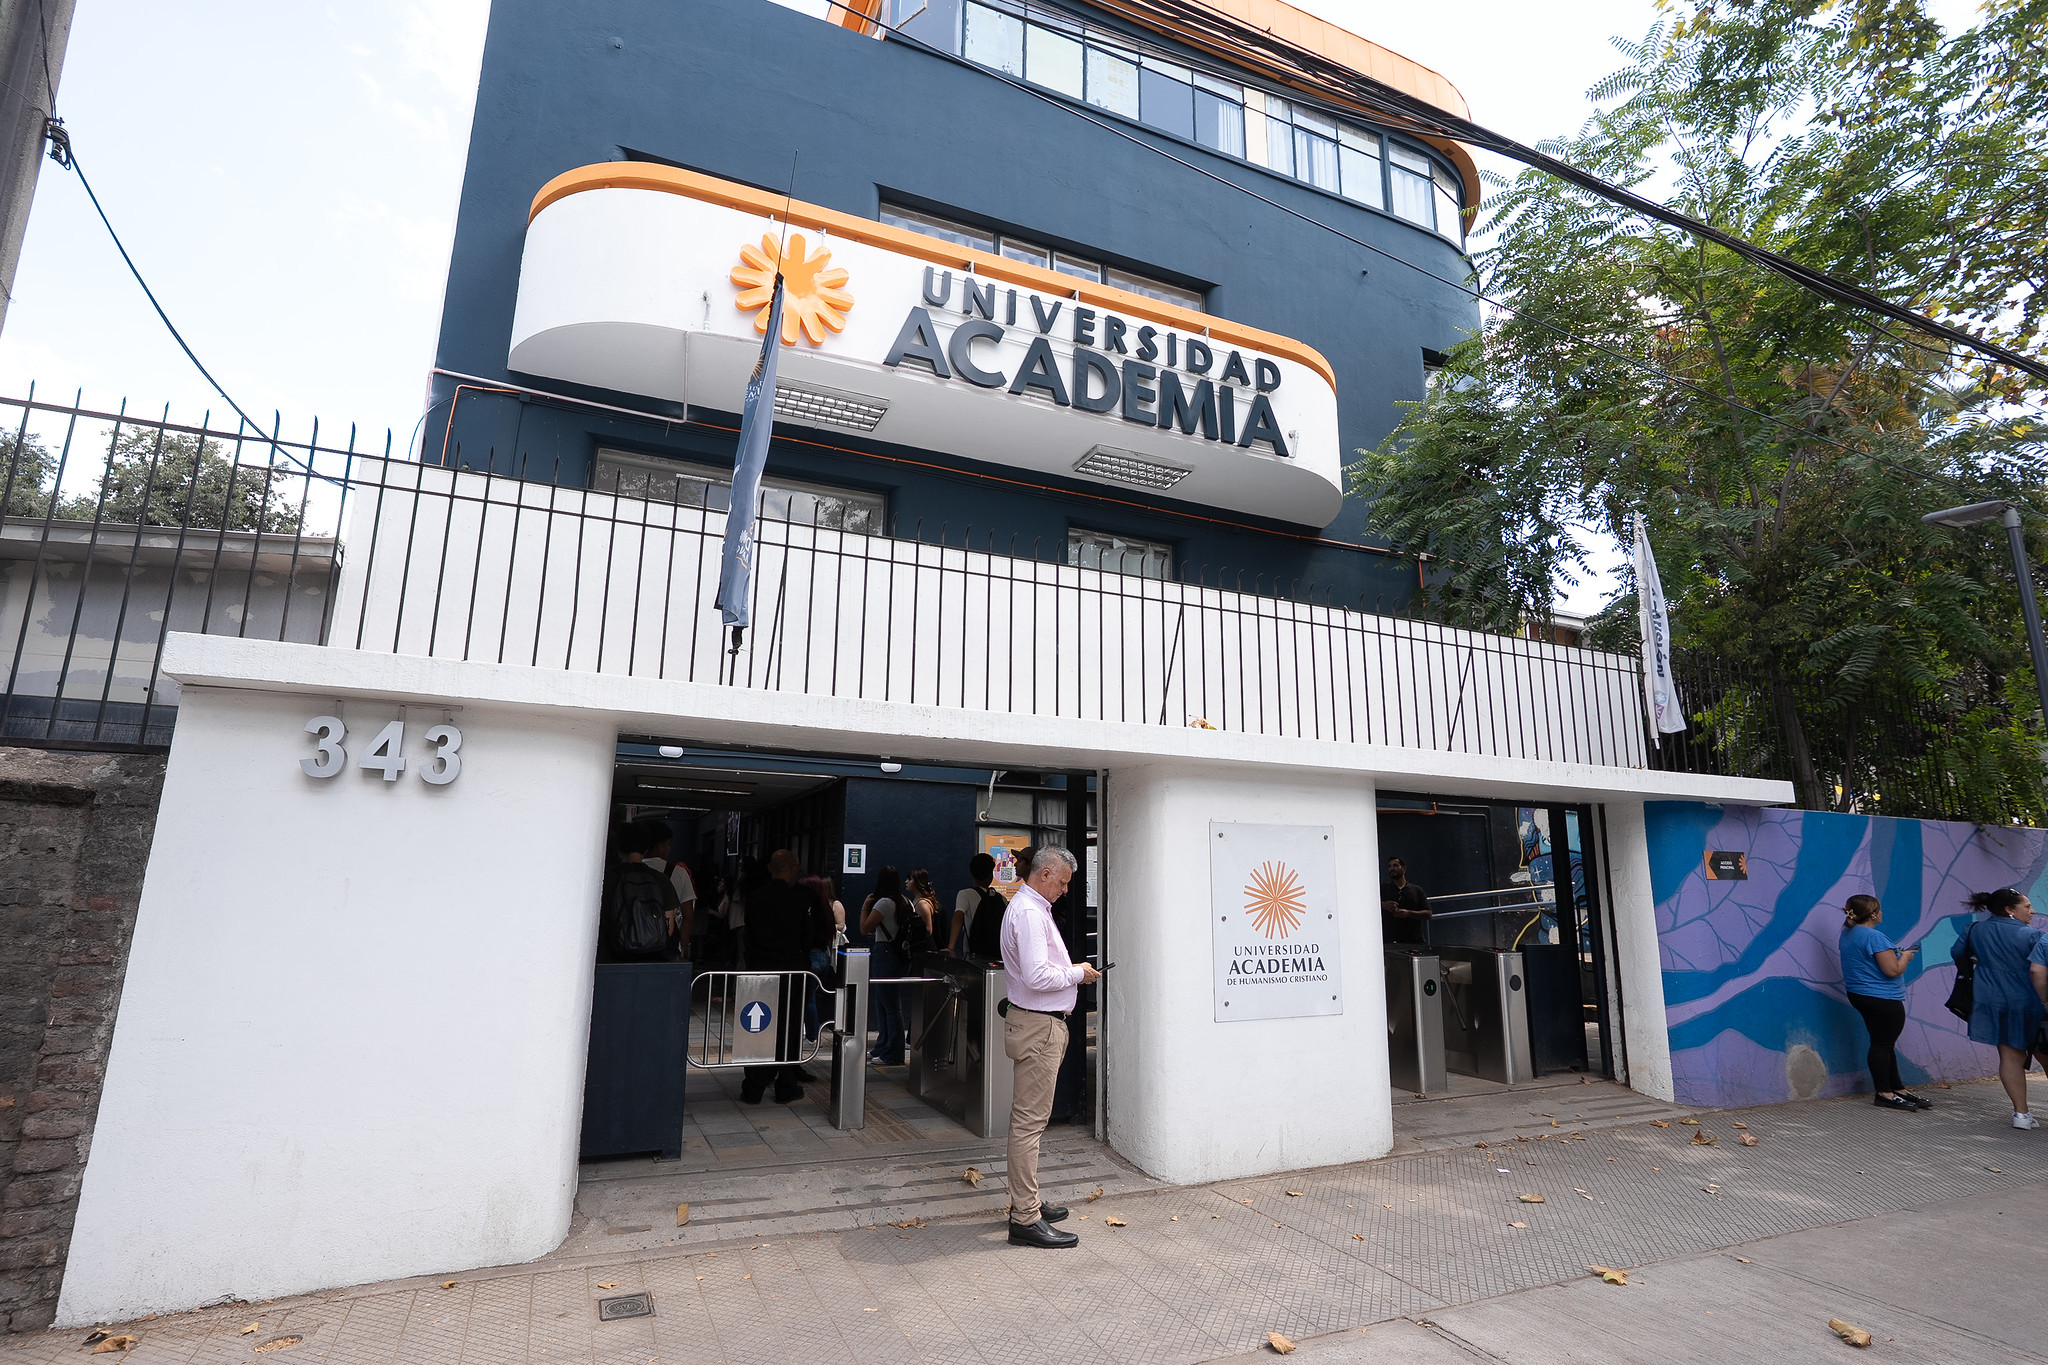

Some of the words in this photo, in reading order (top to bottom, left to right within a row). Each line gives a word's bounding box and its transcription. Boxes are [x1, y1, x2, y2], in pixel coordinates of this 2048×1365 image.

[922, 266, 1282, 393] UNIVERSIDAD
[882, 306, 1290, 457] ACADEMIA
[299, 715, 463, 785] 343
[1228, 957, 1326, 975] ACADEMIA
[1234, 943, 1319, 957] UNIVERSIDAD
[1226, 978, 1237, 986] DE
[1239, 976, 1288, 986] HUMANISMO
[1289, 973, 1328, 984] CRISTIANO
